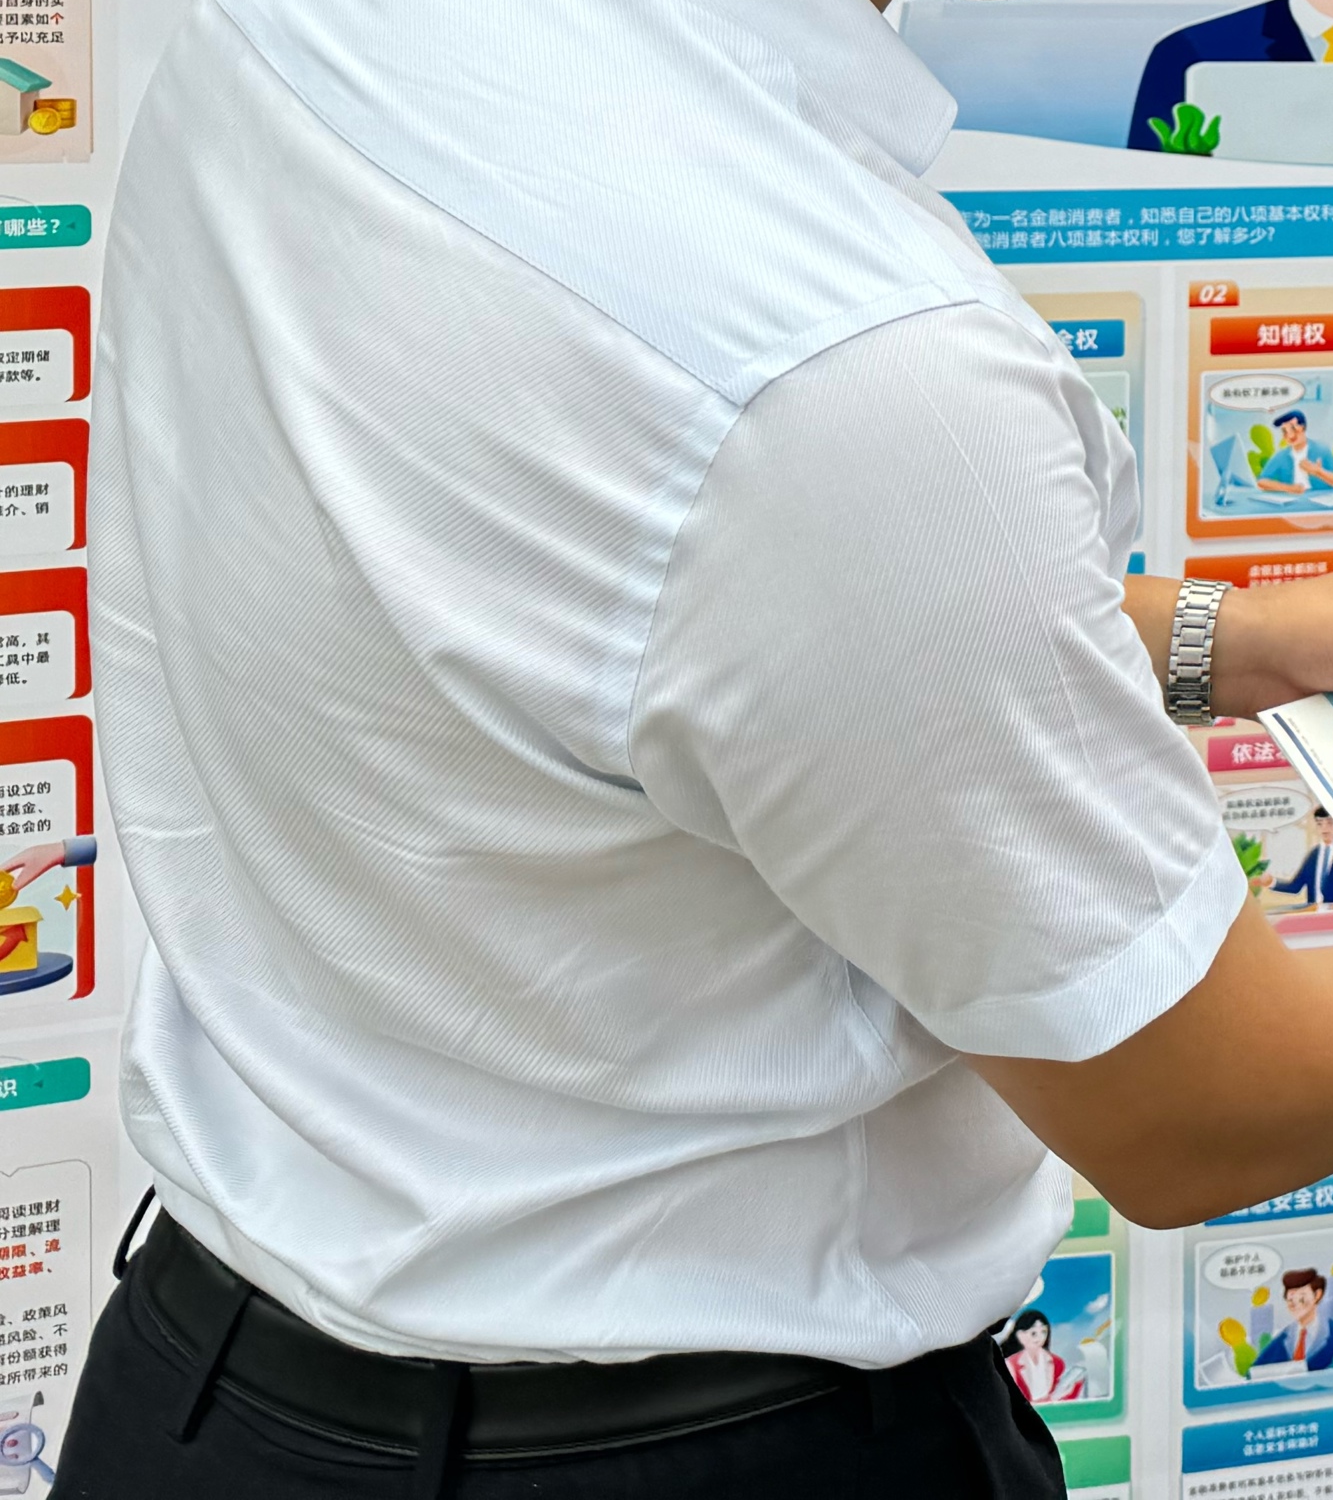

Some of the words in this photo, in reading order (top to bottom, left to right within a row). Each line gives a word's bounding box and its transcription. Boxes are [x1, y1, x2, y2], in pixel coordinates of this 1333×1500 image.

[0, 12, 65, 26] 因素如个
[0, 30, 65, 45] 予以充足
[0, 218, 61, 236] 哪些?
[1199, 285, 1228, 304] 02
[1257, 322, 1326, 348] 知情权
[0, 369, 42, 384] 款等。
[0, 482, 50, 498] 的理财
[0, 501, 50, 518] 介、销
[0, 672, 28, 687] 低。
[1231, 742, 1285, 765] 依法
[0, 819, 52, 836] 金会的
